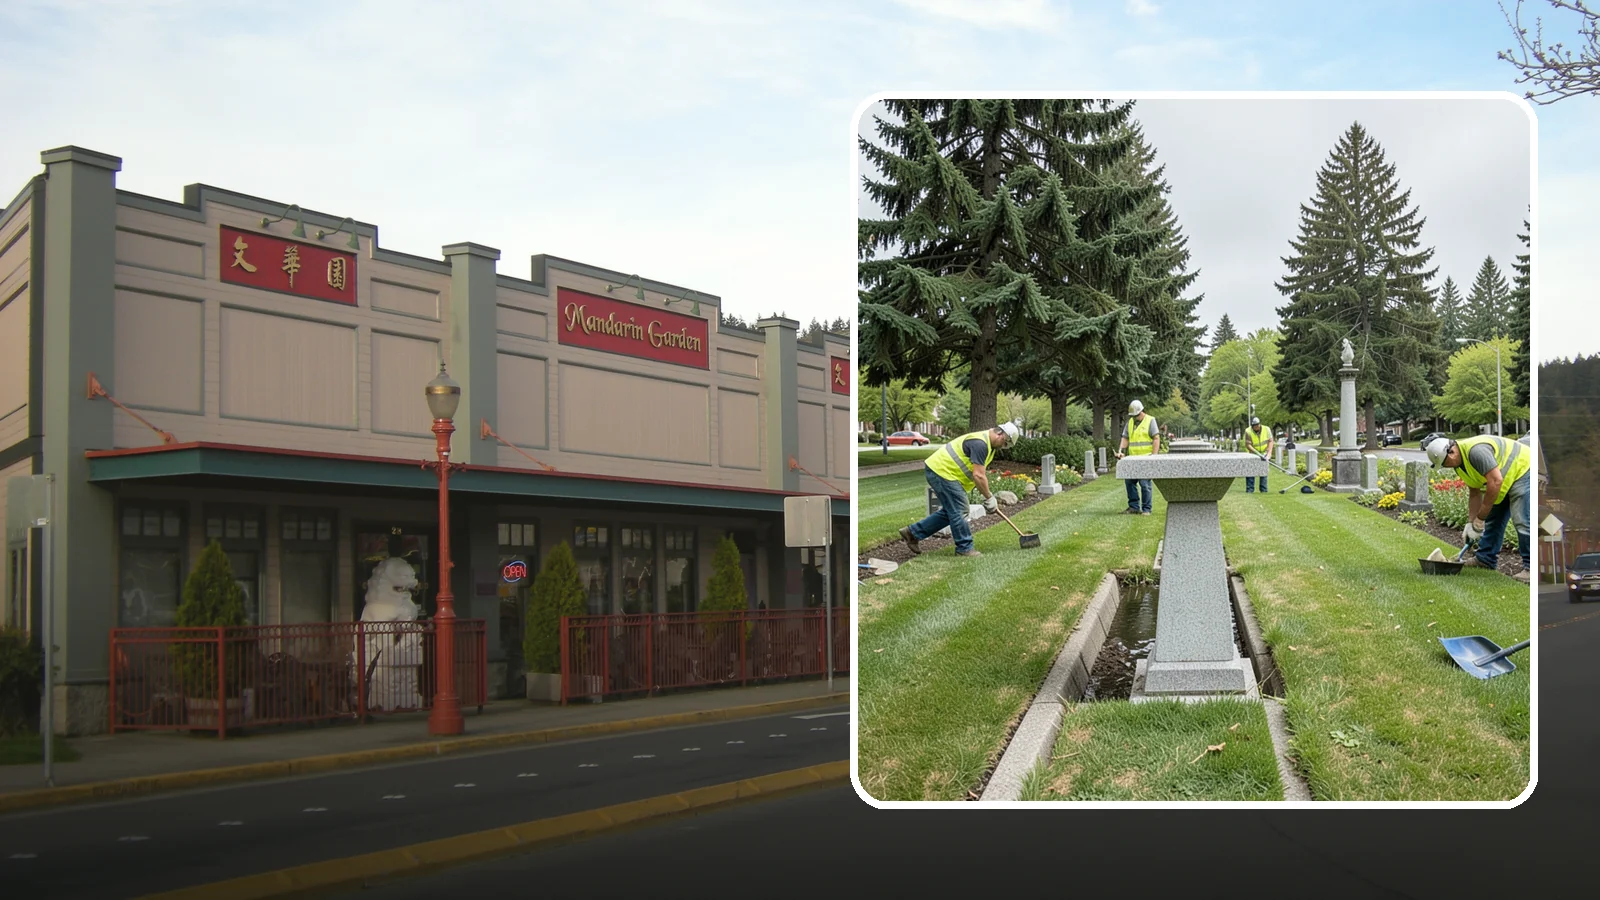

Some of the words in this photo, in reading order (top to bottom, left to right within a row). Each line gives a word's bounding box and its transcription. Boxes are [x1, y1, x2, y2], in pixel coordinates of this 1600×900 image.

[231, 235, 347, 291] 文華園
[564, 302, 644, 341] Mandarin
[647, 320, 702, 352] Garden
[835, 363, 846, 386] 文
[503, 565, 527, 578] OPEN
